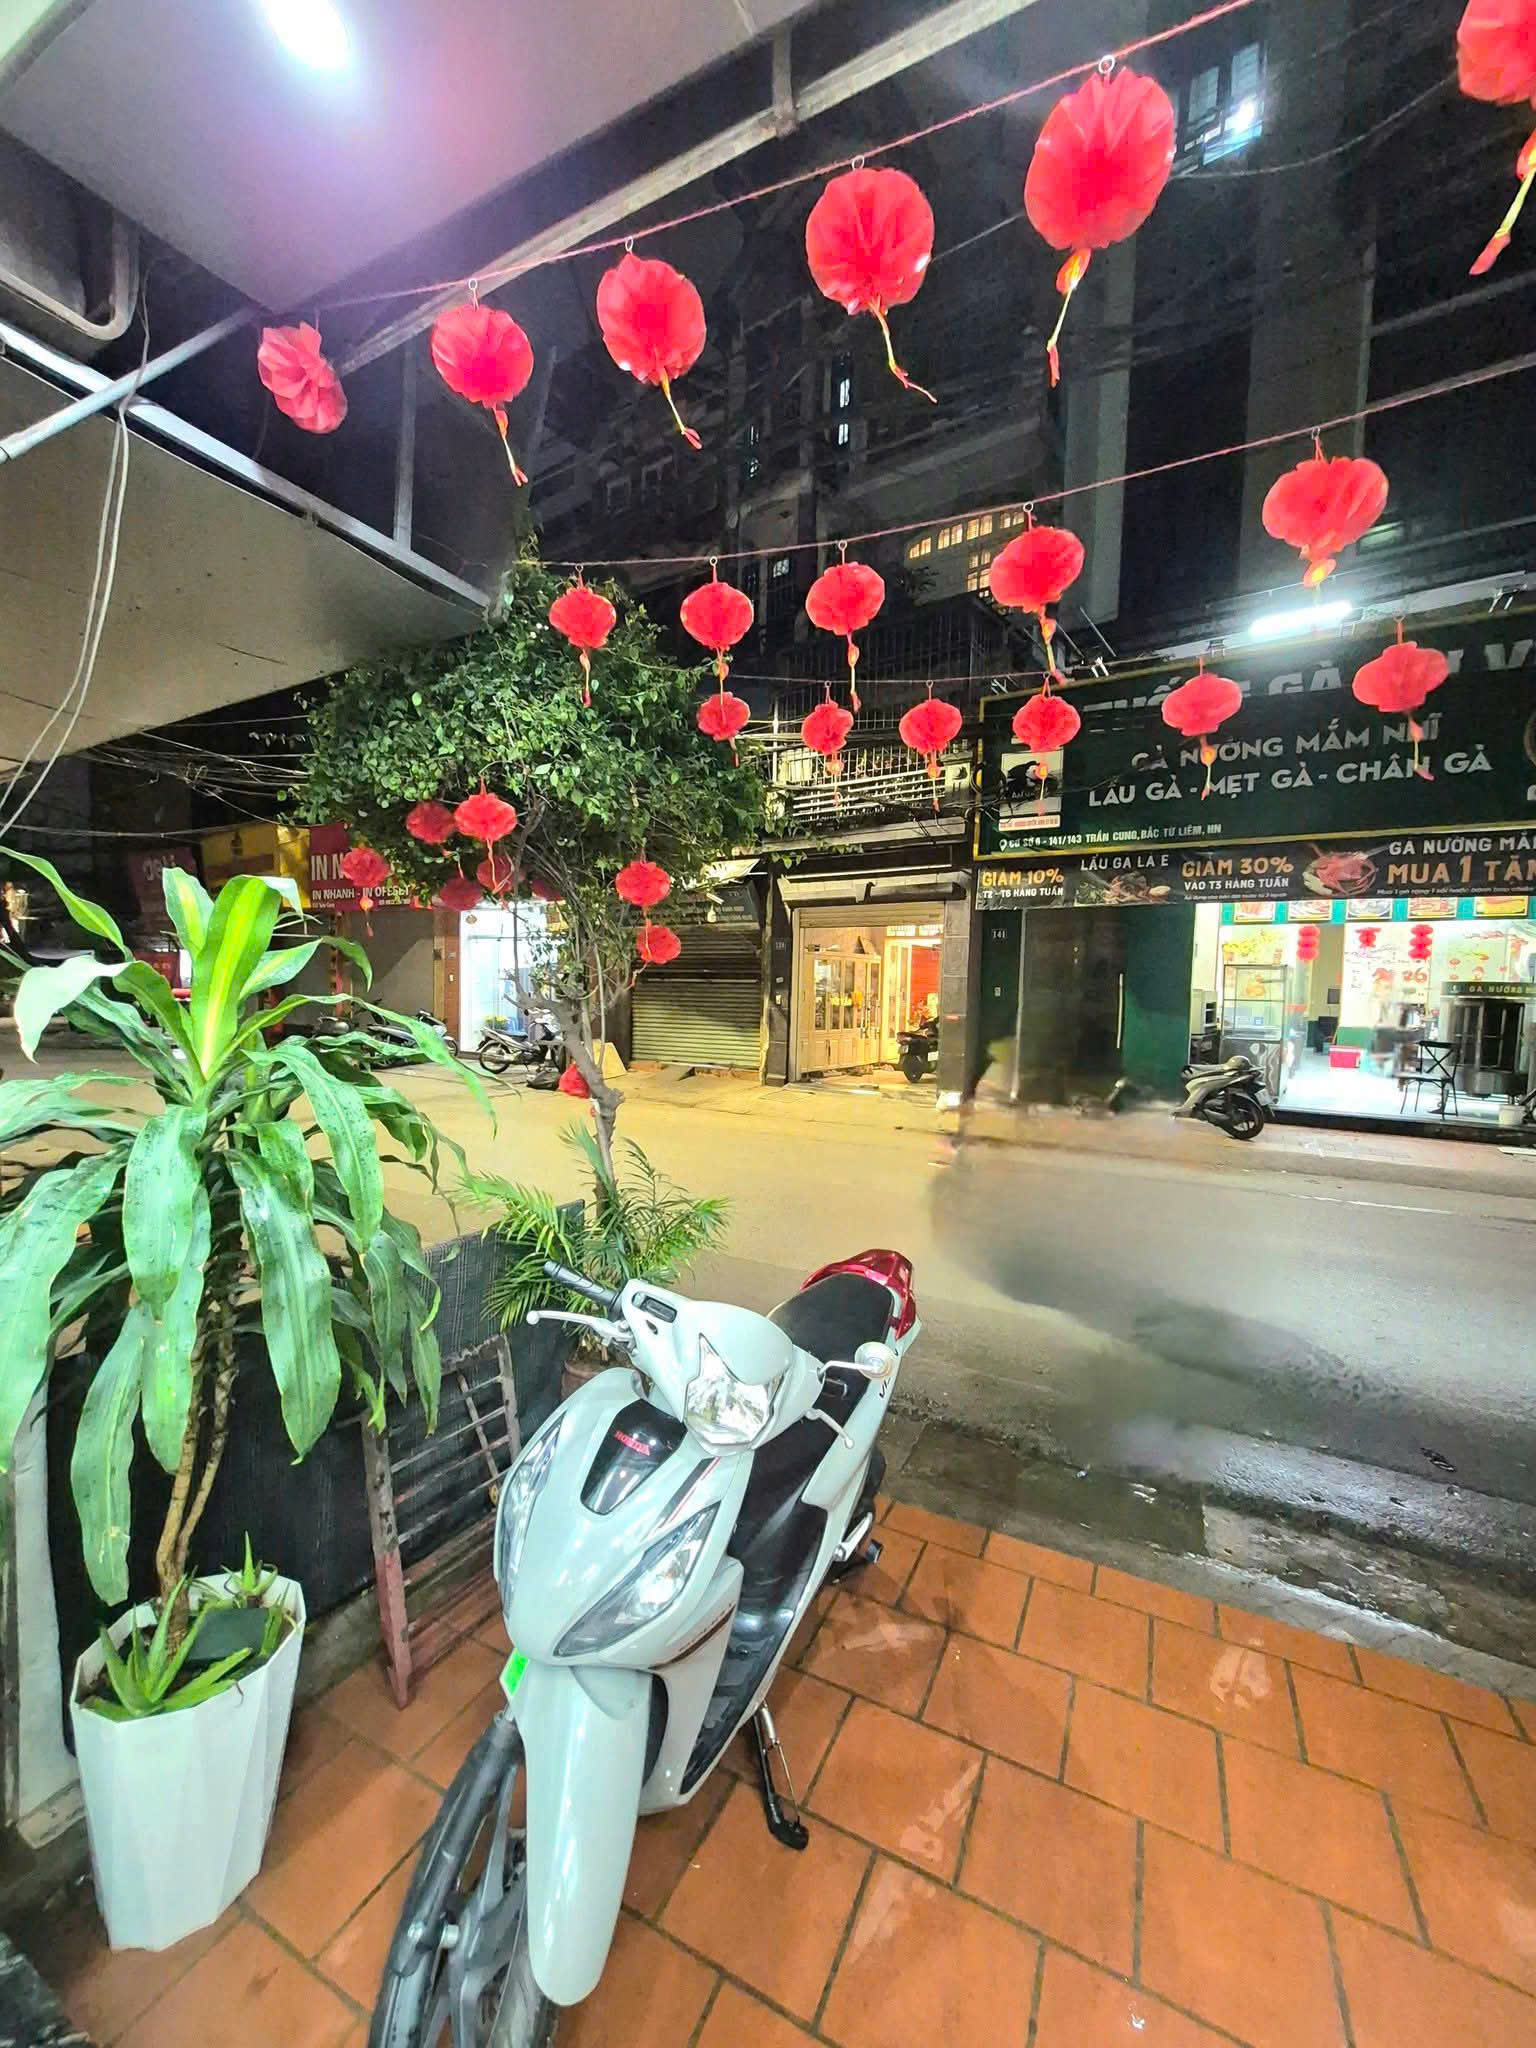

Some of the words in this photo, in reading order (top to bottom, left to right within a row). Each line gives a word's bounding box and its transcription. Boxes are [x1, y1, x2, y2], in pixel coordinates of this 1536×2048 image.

[1296, 717, 1370, 754] MẮM
[1145, 774, 1182, 801] GÀ
[1271, 761, 1313, 790] GÀ
[1336, 753, 1432, 784] CHÂN
[1444, 744, 1493, 774] GÀ
[311, 854, 328, 880] IN
[1027, 868, 1064, 884] 10%
[1240, 857, 1294, 875] 30%
[1387, 863, 1450, 884] MUA
[1460, 855, 1472, 883] 1
